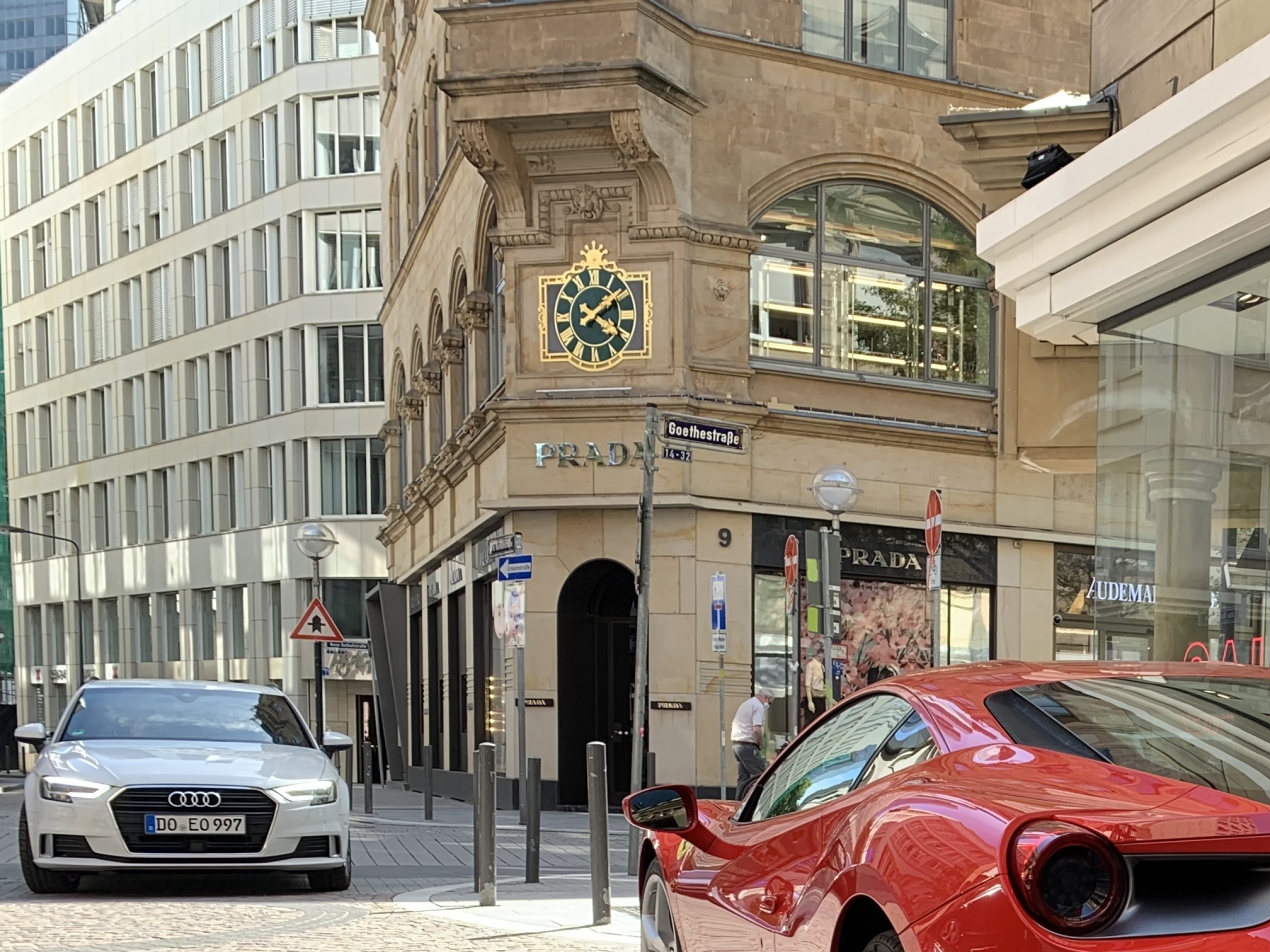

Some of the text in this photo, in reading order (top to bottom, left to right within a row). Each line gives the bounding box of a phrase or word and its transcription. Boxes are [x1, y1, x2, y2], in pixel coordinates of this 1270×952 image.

[668, 422, 740, 446] Goethestraße
[664, 447, 691, 462] 14-32
[718, 528, 732, 547] 9
[840, 547, 922, 571] PRADA
[156, 817, 178, 831] DO
[188, 817, 209, 831] EO
[213, 818, 242, 832] 997
